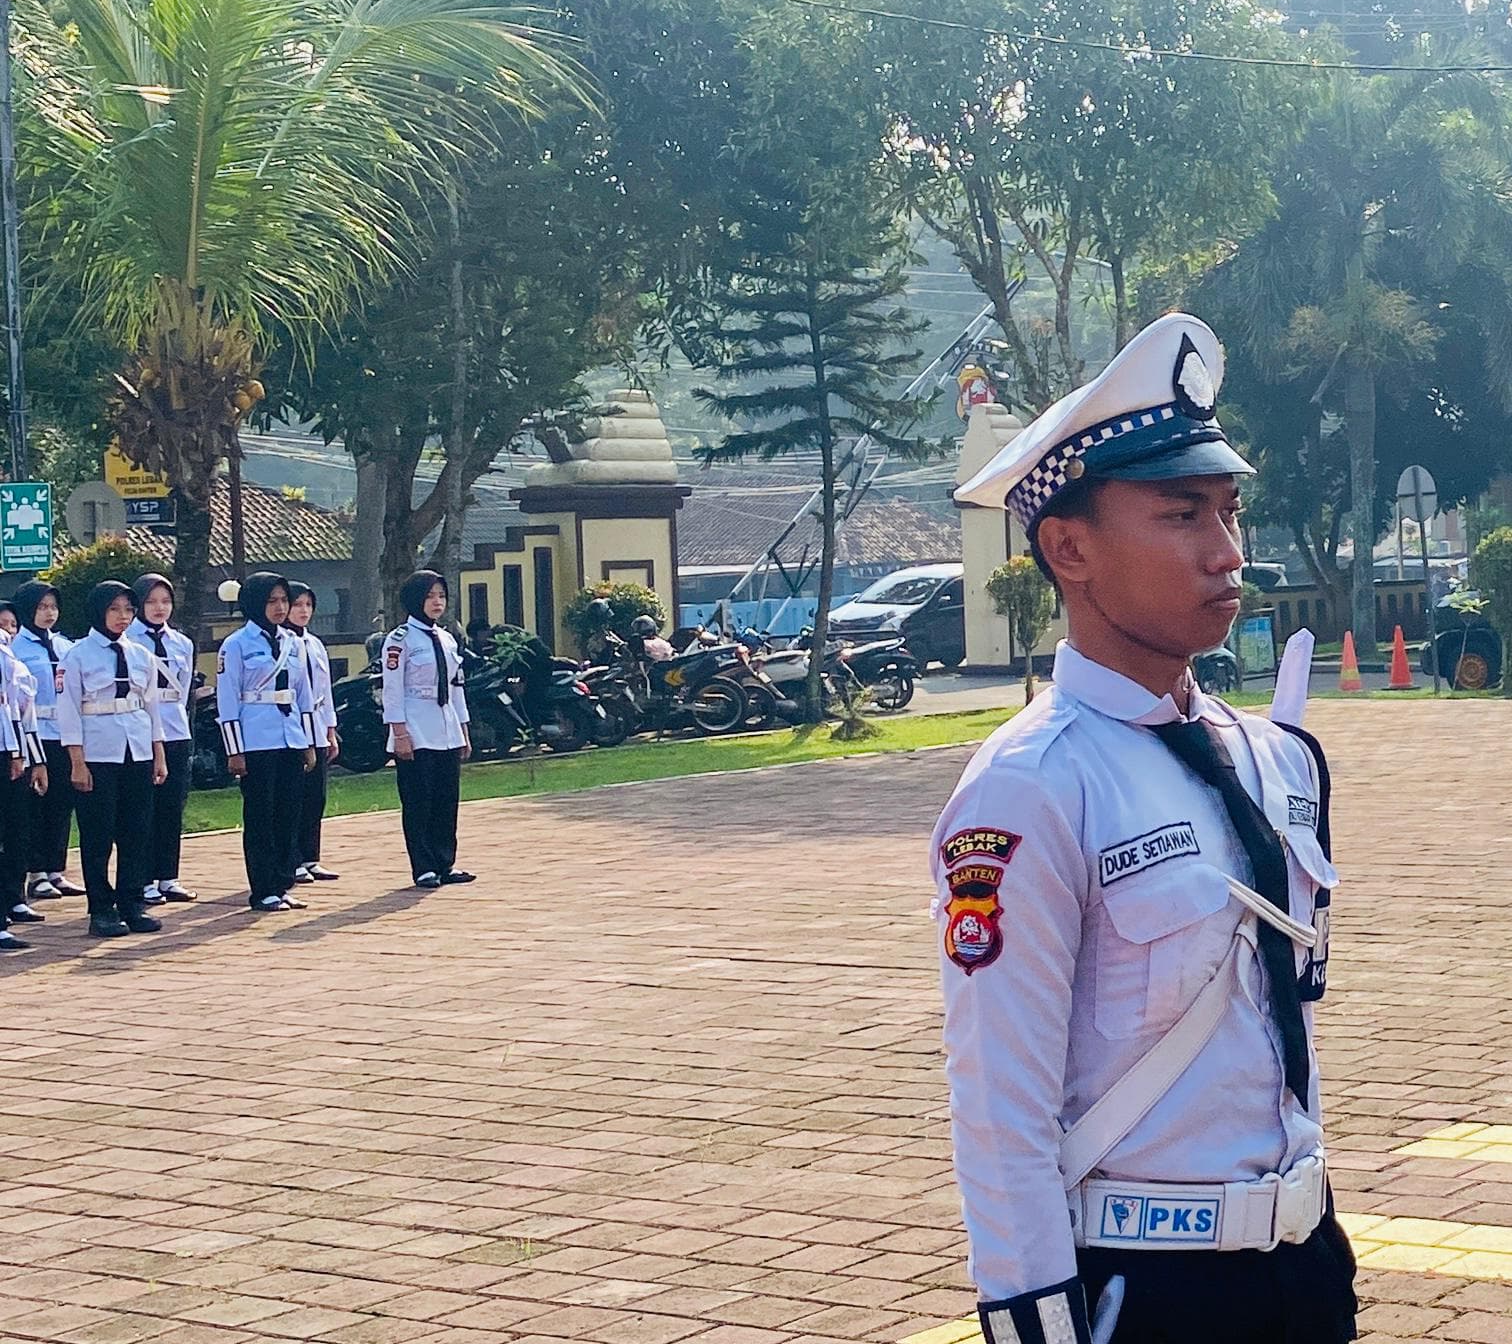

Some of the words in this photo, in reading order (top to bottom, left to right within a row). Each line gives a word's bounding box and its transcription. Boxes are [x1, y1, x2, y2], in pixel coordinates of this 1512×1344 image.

[947, 832, 1008, 852] POLRES
[952, 842, 998, 857] LEBAK
[1104, 847, 1139, 876] DUDE
[1143, 829, 1193, 860] SETIAWAN
[952, 867, 997, 884] BANTEN
[1149, 1207, 1213, 1233] PKS
